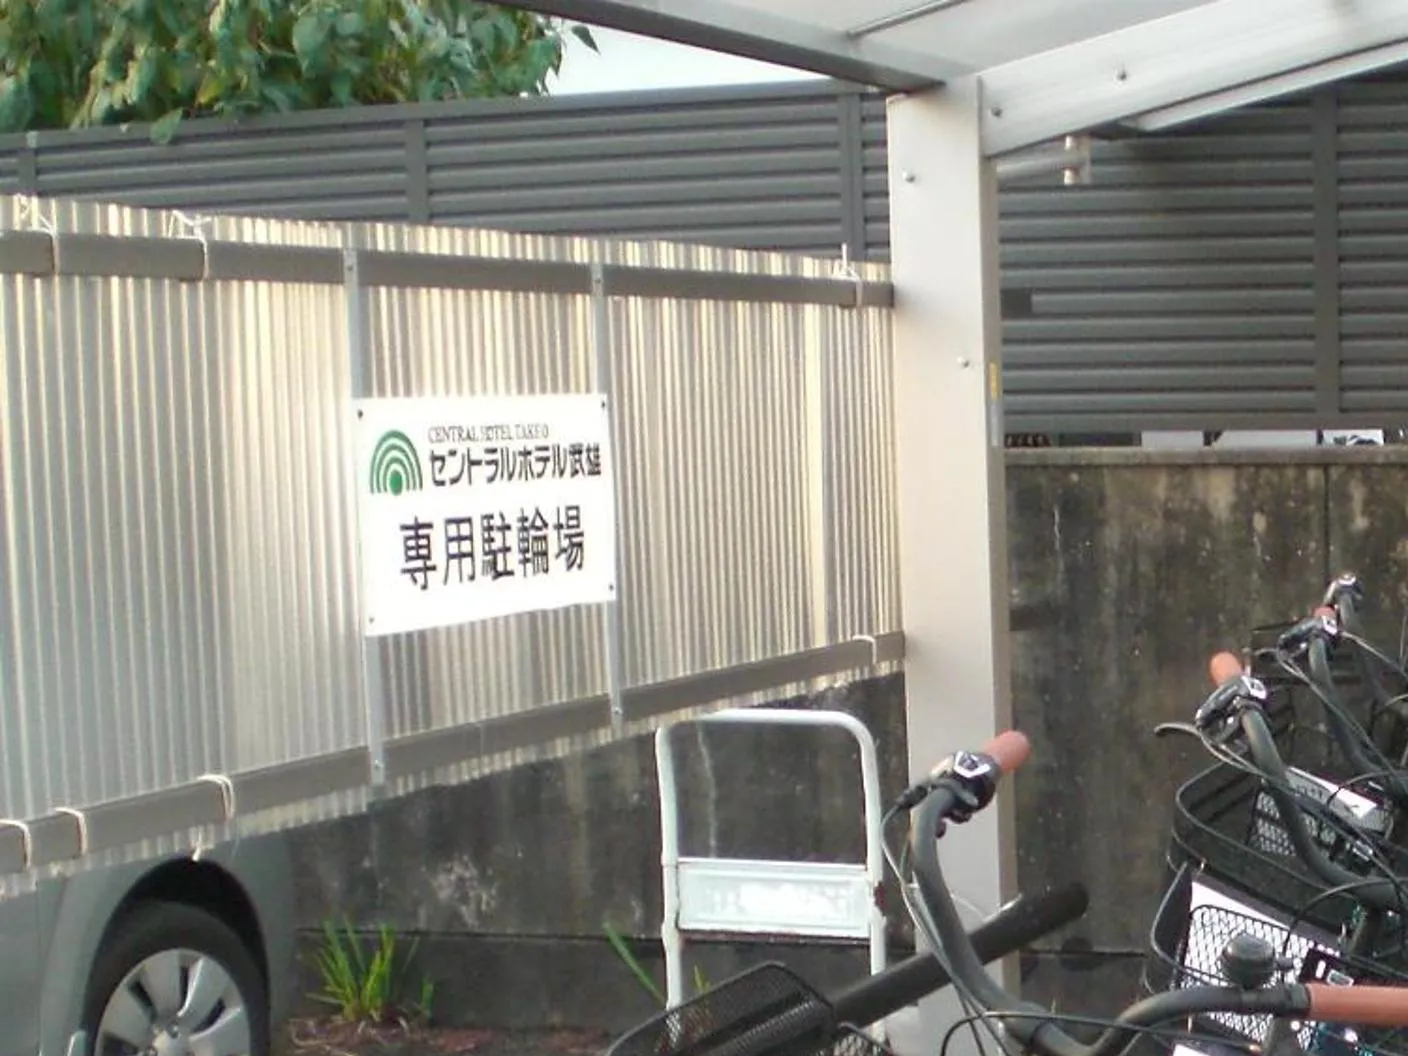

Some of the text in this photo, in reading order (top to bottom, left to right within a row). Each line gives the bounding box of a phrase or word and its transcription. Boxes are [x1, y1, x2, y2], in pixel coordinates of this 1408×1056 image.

[427, 424, 479, 443] CENTRAL
[480, 424, 513, 441] HOTEL
[429, 442, 602, 487] セントラルホテル武雄
[400, 505, 585, 591] 専用駐輪場
